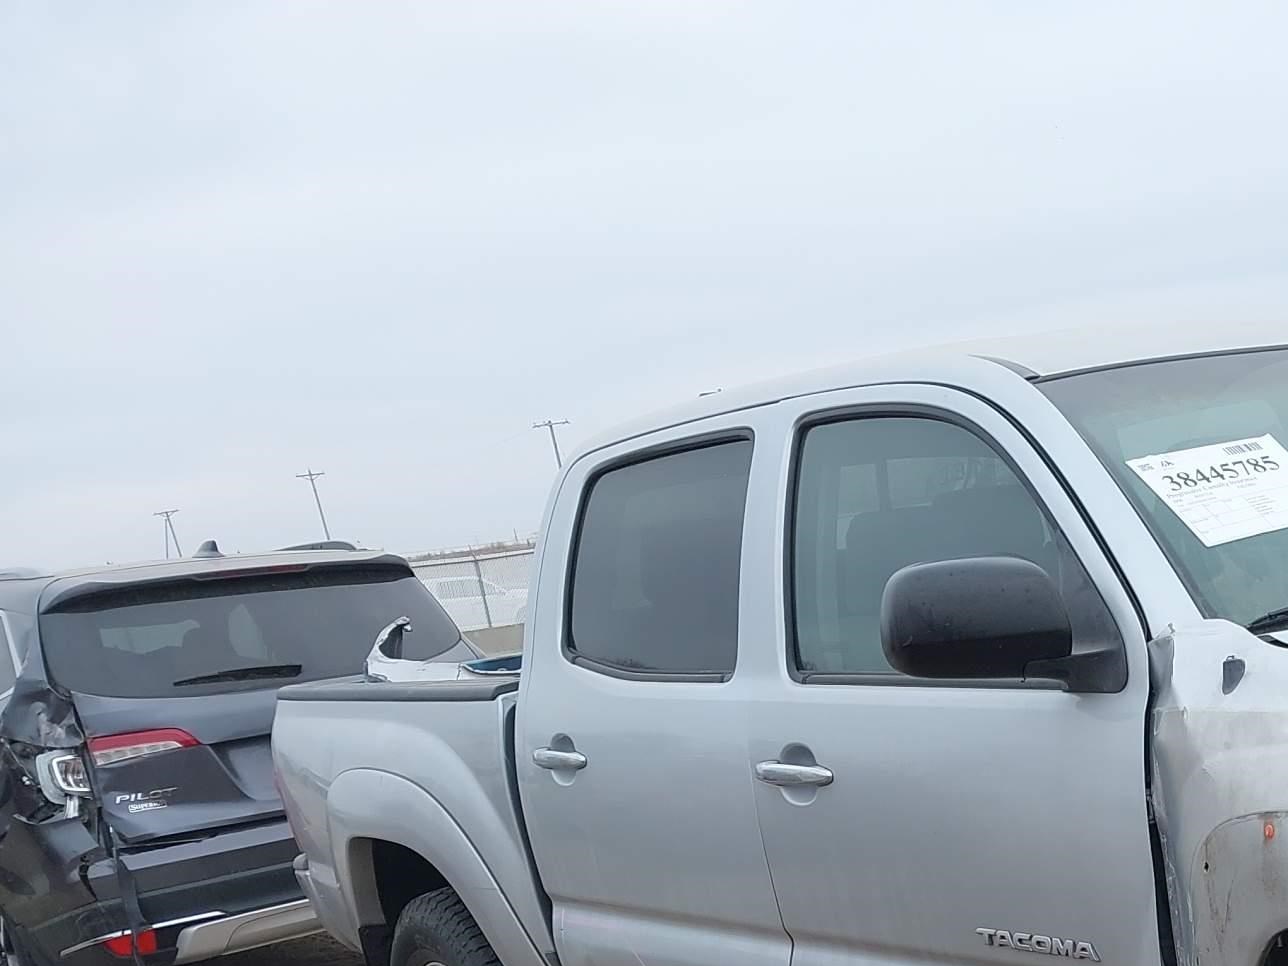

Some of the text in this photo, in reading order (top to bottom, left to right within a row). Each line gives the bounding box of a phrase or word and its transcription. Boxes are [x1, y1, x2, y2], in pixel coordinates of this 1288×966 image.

[1162, 456, 1280, 491] 38445785
[115, 786, 178, 804] PILOT
[975, 927, 1101, 962] TACOMA
